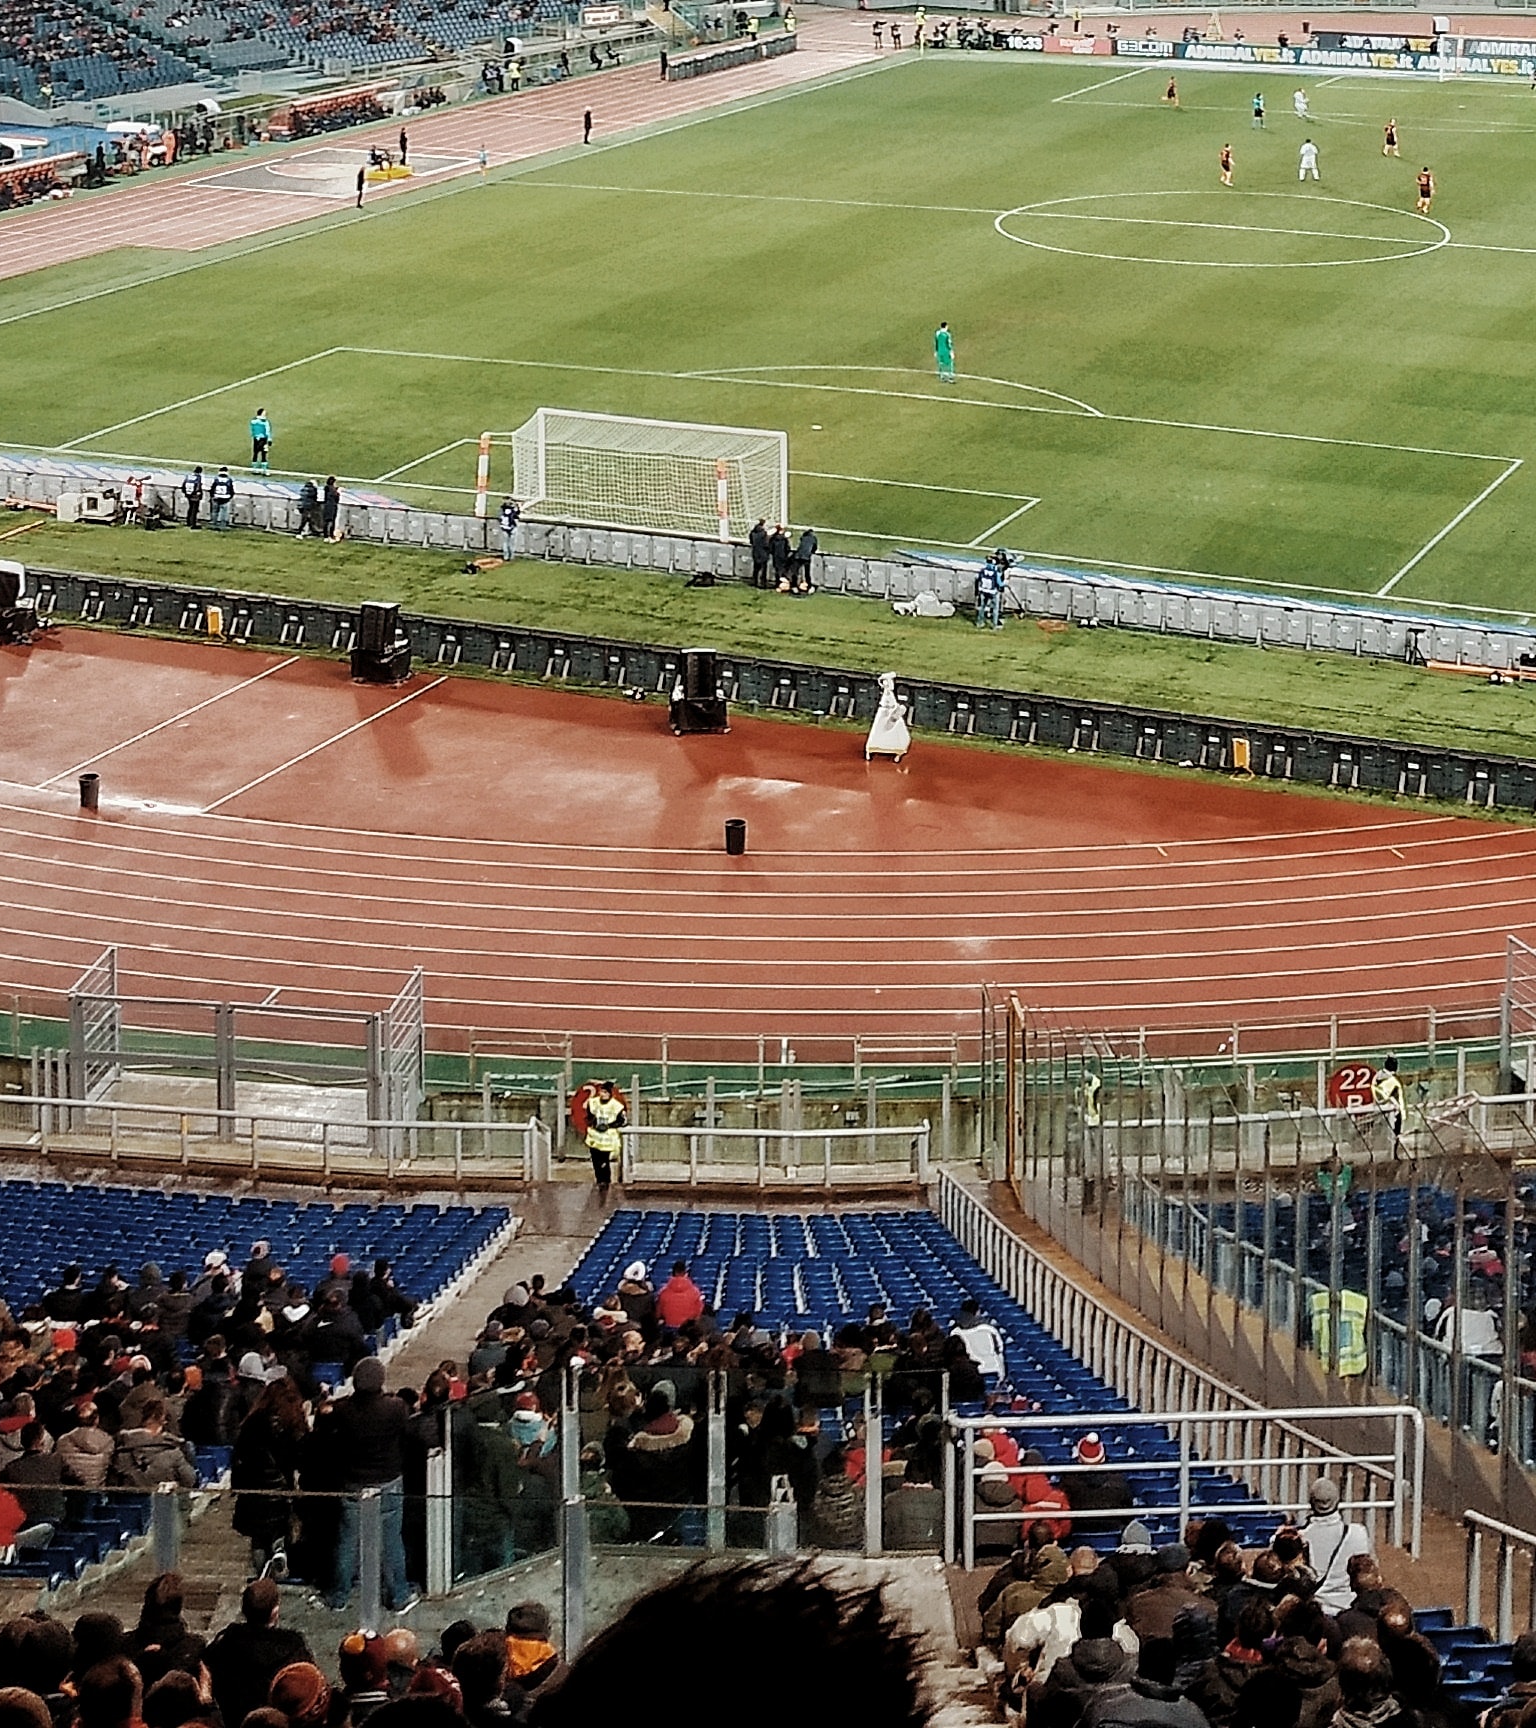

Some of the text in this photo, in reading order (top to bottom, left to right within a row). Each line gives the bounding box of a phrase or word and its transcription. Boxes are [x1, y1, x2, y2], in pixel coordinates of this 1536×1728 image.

[1184, 43, 1296, 64] ADMIRALYES.it
[1299, 49, 1414, 70] ADMIRALYES.it
[1339, 1067, 1372, 1091] 22
